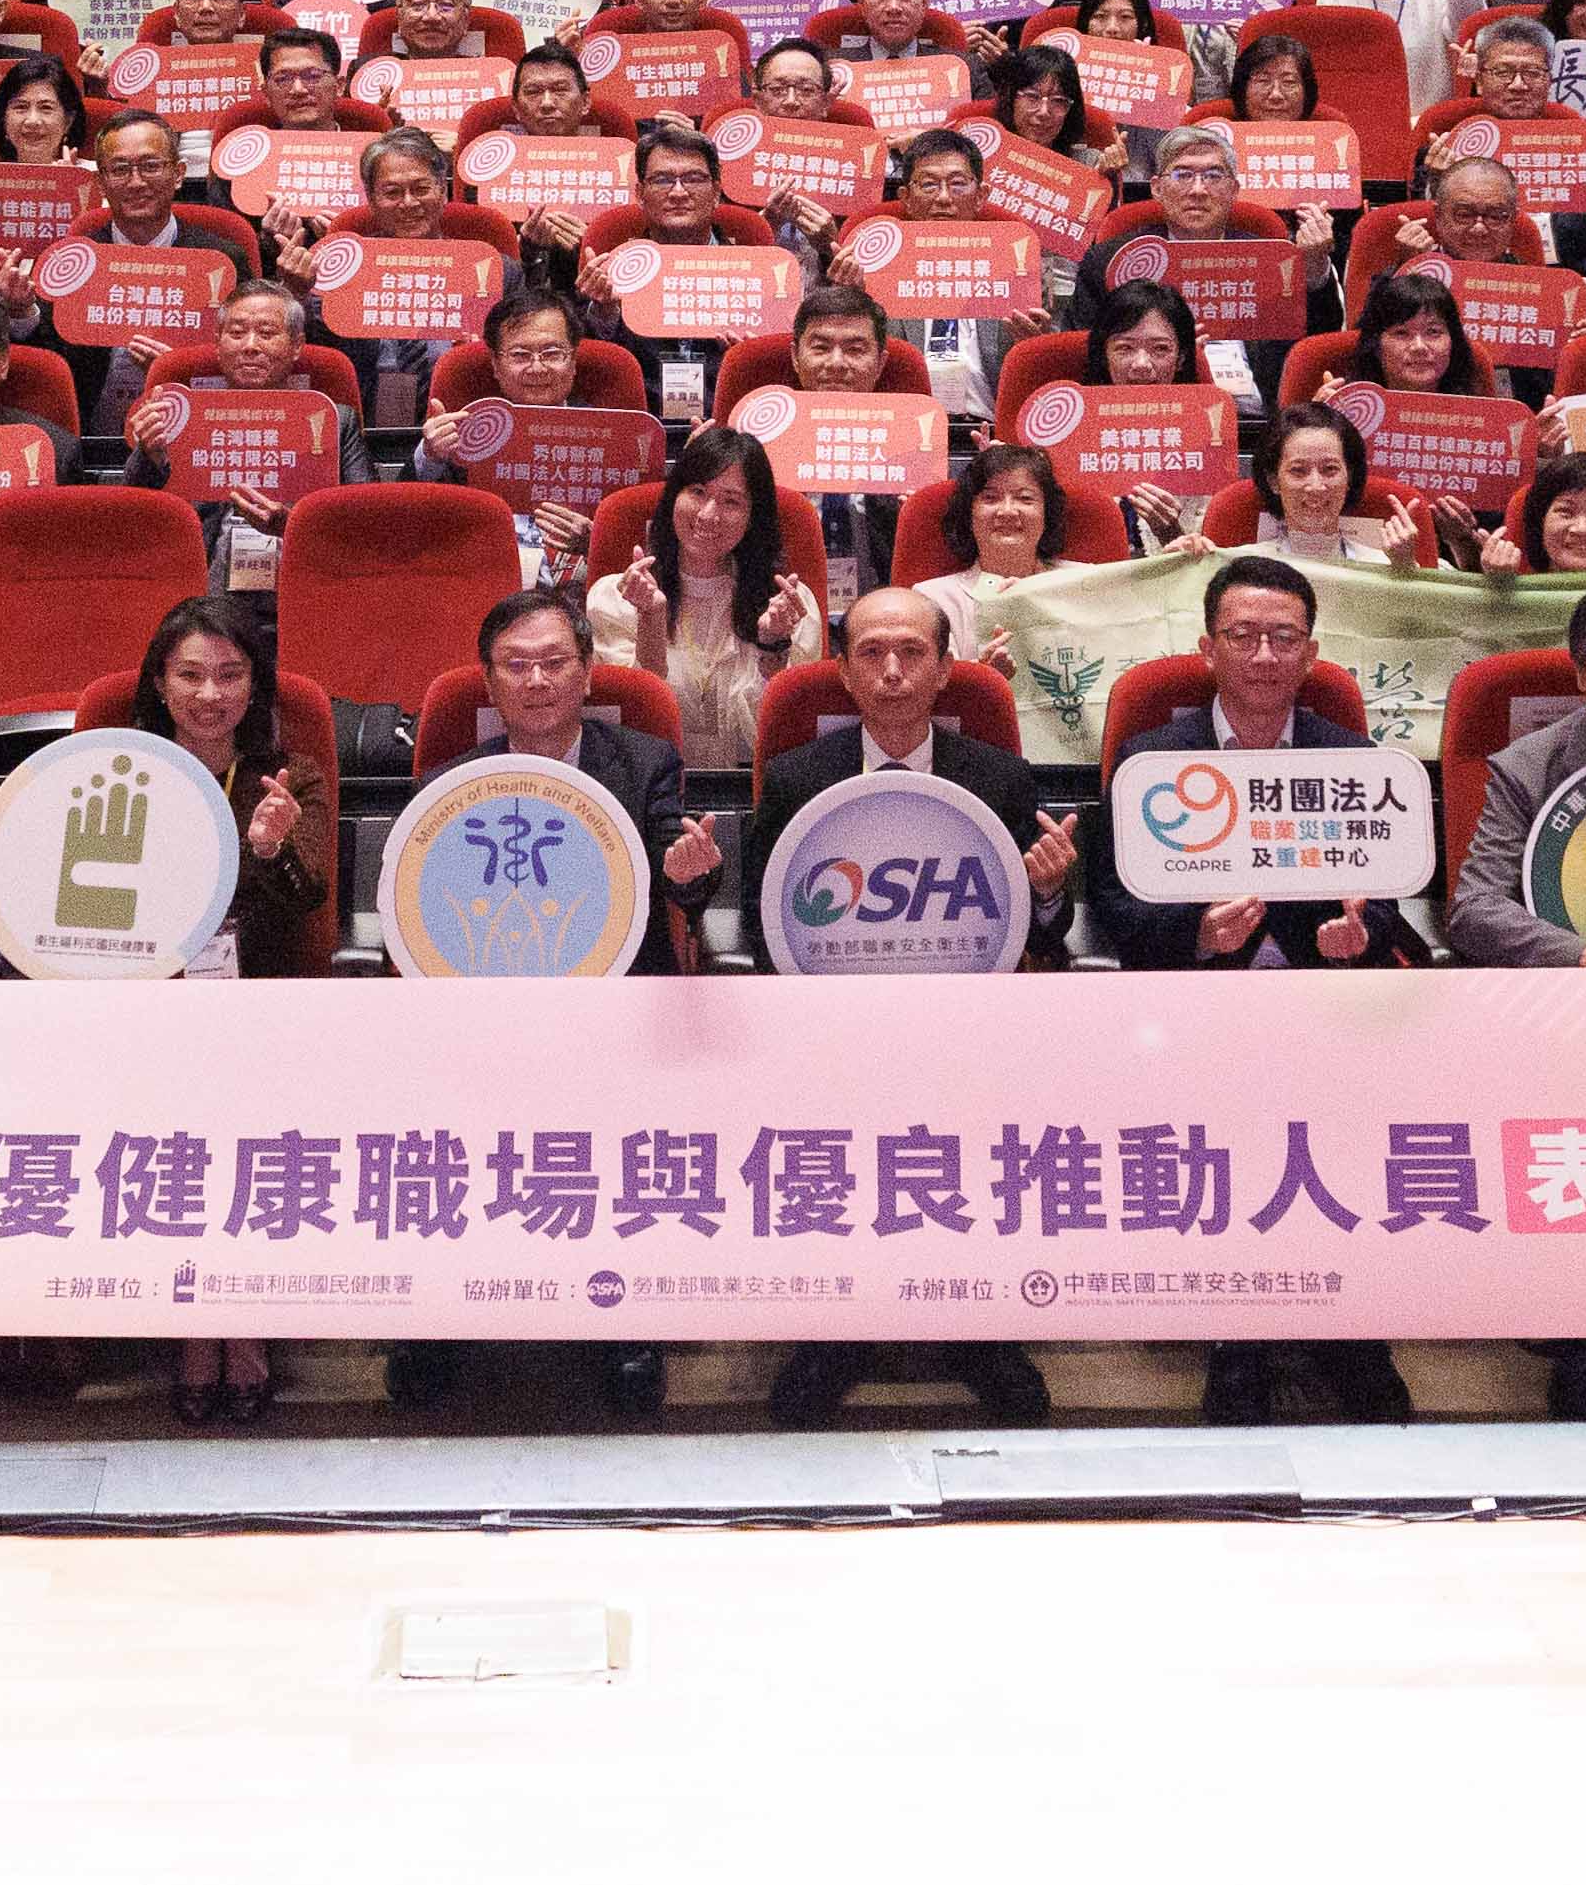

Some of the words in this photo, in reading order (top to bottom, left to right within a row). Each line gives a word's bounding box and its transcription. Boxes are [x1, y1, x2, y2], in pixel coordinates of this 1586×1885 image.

[297, 11, 351, 32] 新竹
[626, 63, 705, 80] 衛生福利部
[155, 77, 251, 96] 華南商業銀行
[754, 152, 857, 176] 安侯建業聯合
[1247, 155, 1314, 171] 奇美醫療
[916, 260, 991, 278] 和泰興業
[382, 275, 447, 290] 台灣電力
[662, 275, 762, 292] 好好國際物流
[1182, 280, 1257, 297] 新北市立
[108, 284, 184, 305] 台灣晶技
[1101, 428, 1181, 448] 美律實業
[816, 447, 886, 462] 財團法人
[1248, 777, 1408, 816] 財團法人
[1249, 819, 1392, 844] 職業災害預防
[1165, 858, 1233, 873] COAPRE
[1251, 846, 1369, 869] 及重建中心
[807, 936, 989, 957] 勞動部職業安全衛生署
[201, 1274, 413, 1295] 衛生福利部國民健康署
[633, 1276, 854, 1295] 勞動部職業安全衛生署
[1064, 1272, 1343, 1294] 中華民國工業安全衛生協會
